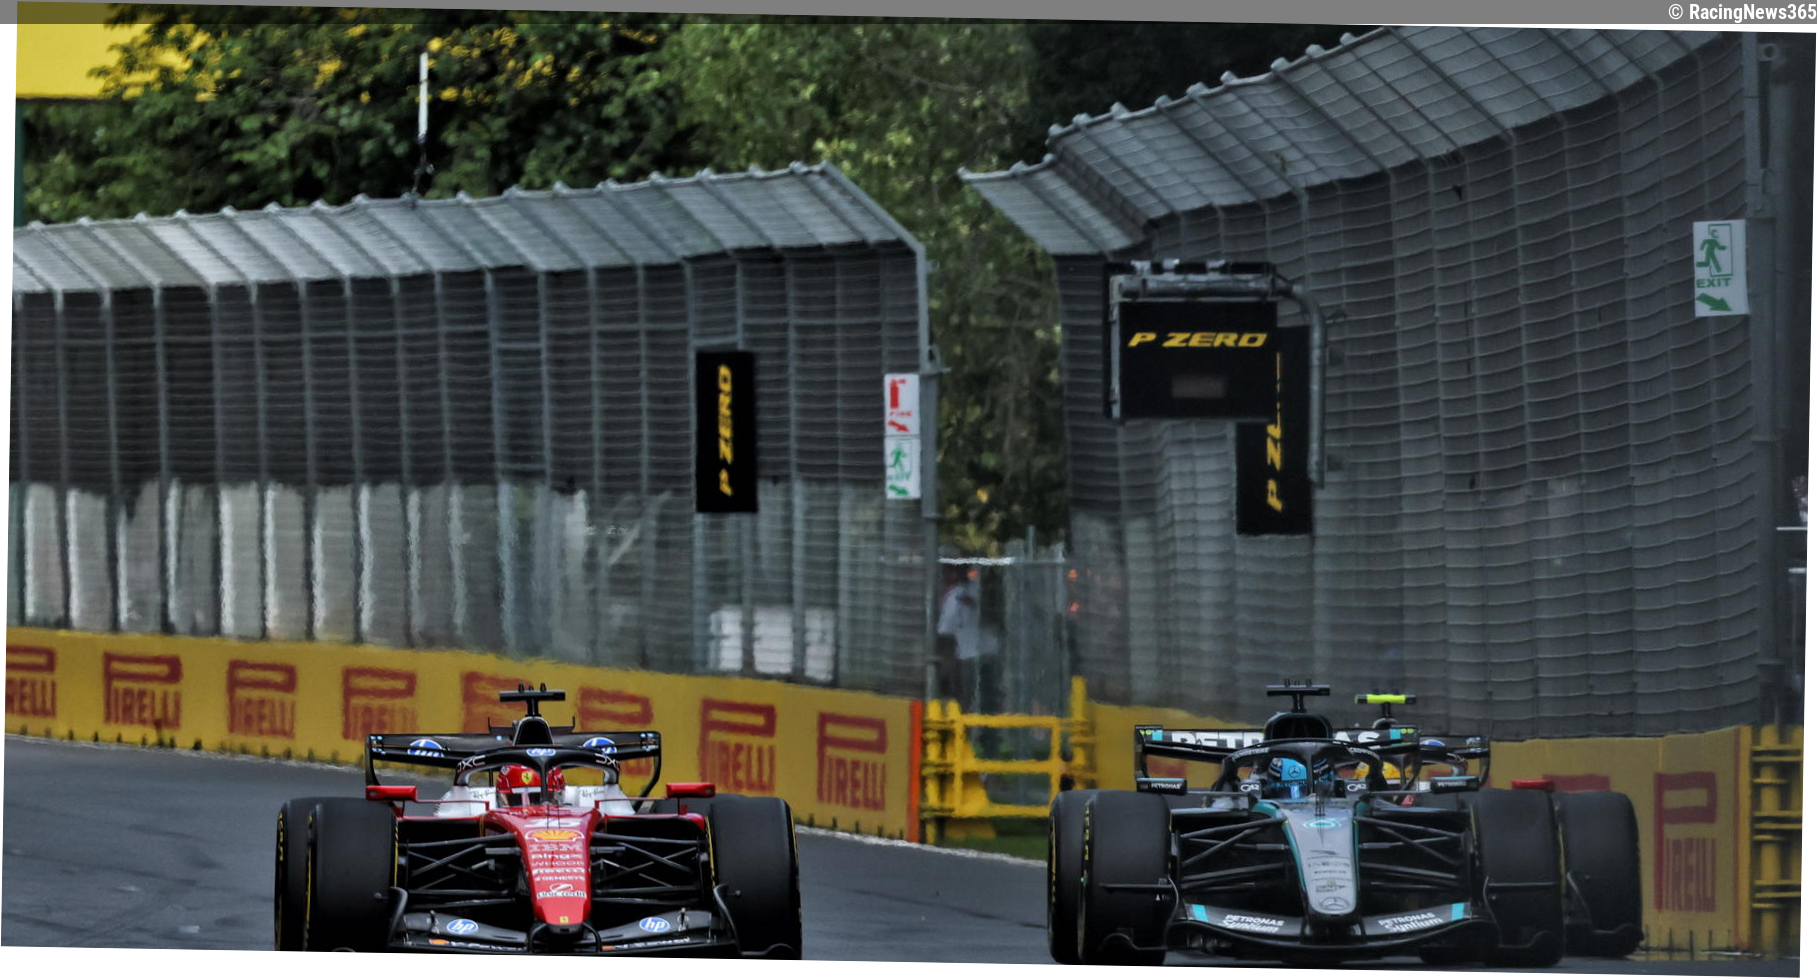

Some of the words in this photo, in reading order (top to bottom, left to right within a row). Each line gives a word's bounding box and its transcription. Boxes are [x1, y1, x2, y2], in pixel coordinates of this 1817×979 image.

[1696, 277, 1732, 288] EXIT
[1127, 332, 1157, 347] P
[1162, 332, 1268, 347] ZERO
[718, 364, 734, 465] ZERO
[718, 468, 734, 496] P
[1266, 479, 1282, 512] P
[103, 652, 182, 729] PIRELLI
[227, 660, 297, 739] PIRELLI
[698, 698, 776, 794] PIRELLI
[816, 712, 888, 811] PIRELLI
[1150, 782, 1182, 790] PETRONAS
[530, 843, 584, 853] IBM
[1654, 771, 1717, 912] PIRELLI
[450, 919, 477, 933] hp
[643, 917, 668, 932] hp
[1223, 914, 1285, 926] PETRONAS
[1377, 912, 1435, 926] PETRONAS
